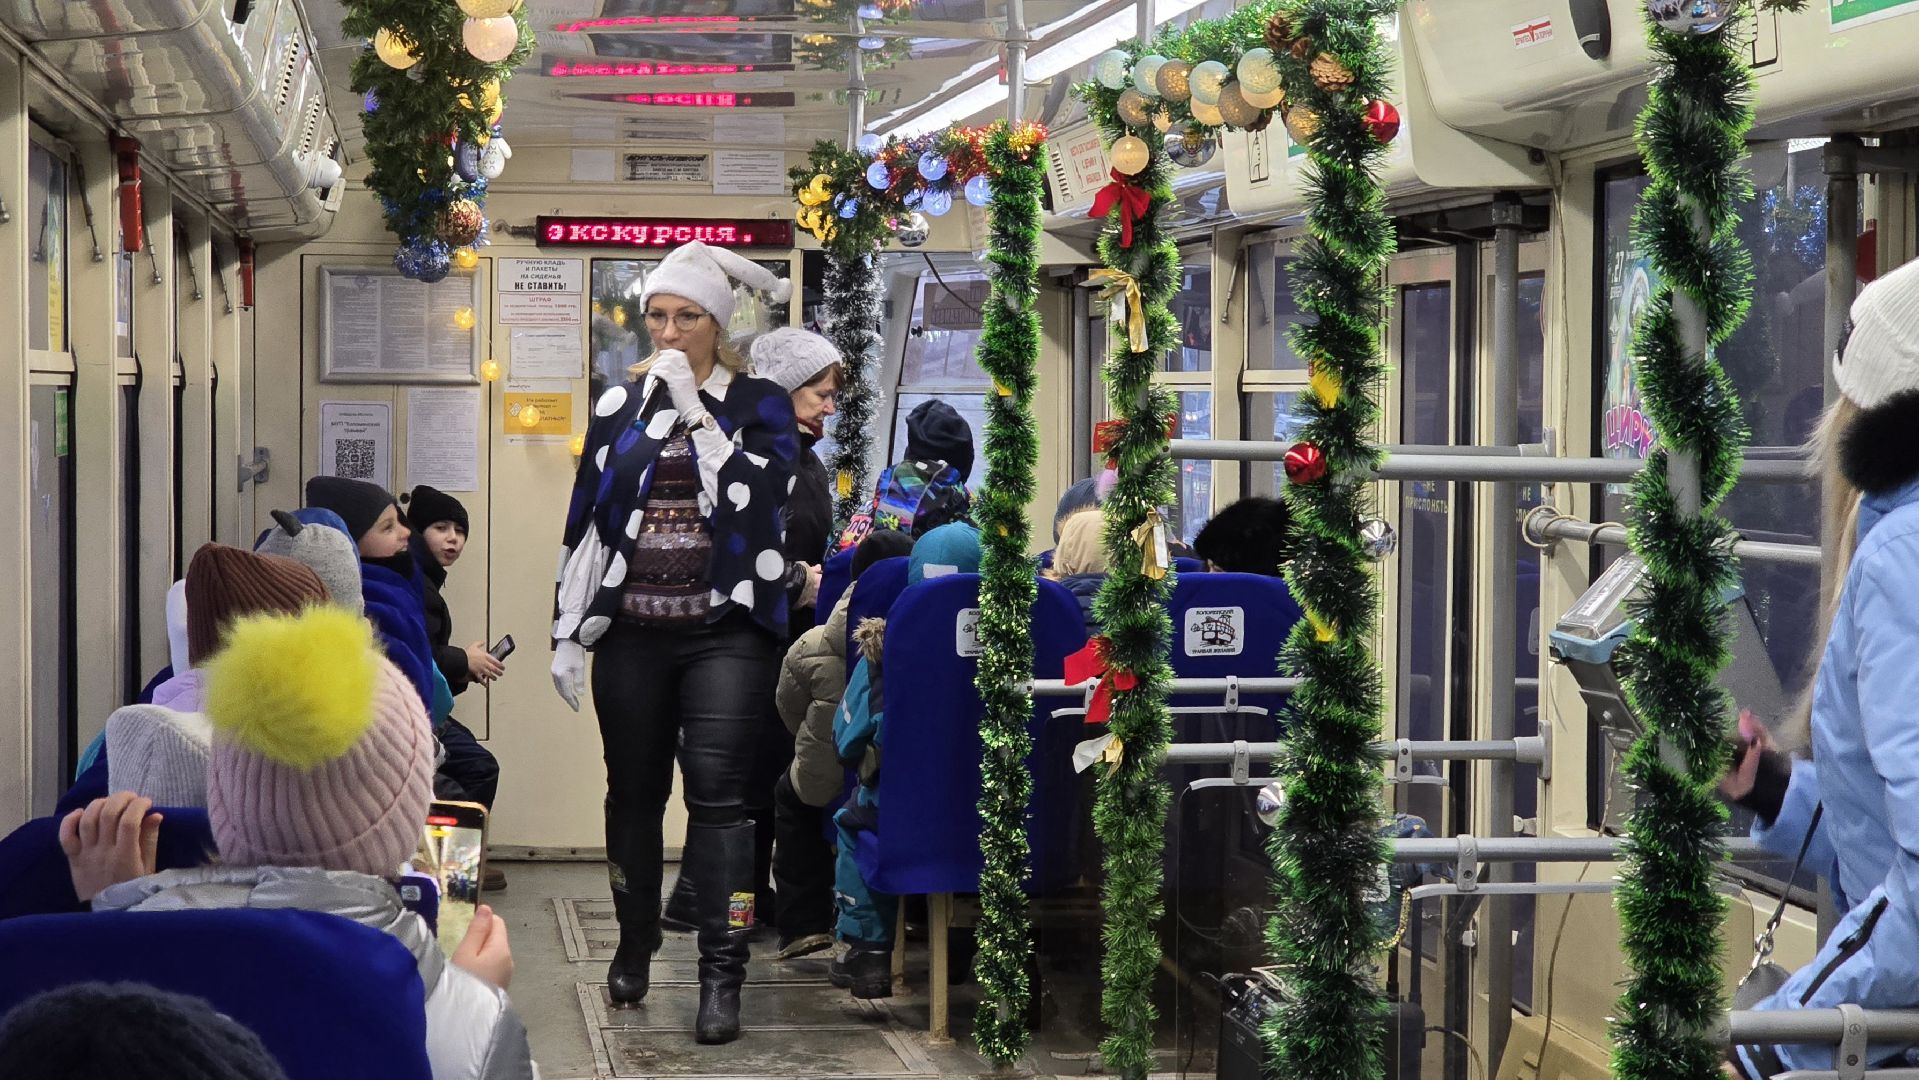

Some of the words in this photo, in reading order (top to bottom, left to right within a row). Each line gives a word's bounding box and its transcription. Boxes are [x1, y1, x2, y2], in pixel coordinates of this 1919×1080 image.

[514, 282, 524, 290] НЕ
[527, 282, 567, 290] СТАВИТЬ!
[1605, 404, 1654, 459] ЦИРК
[1522, 486, 1532, 501] НЕ
